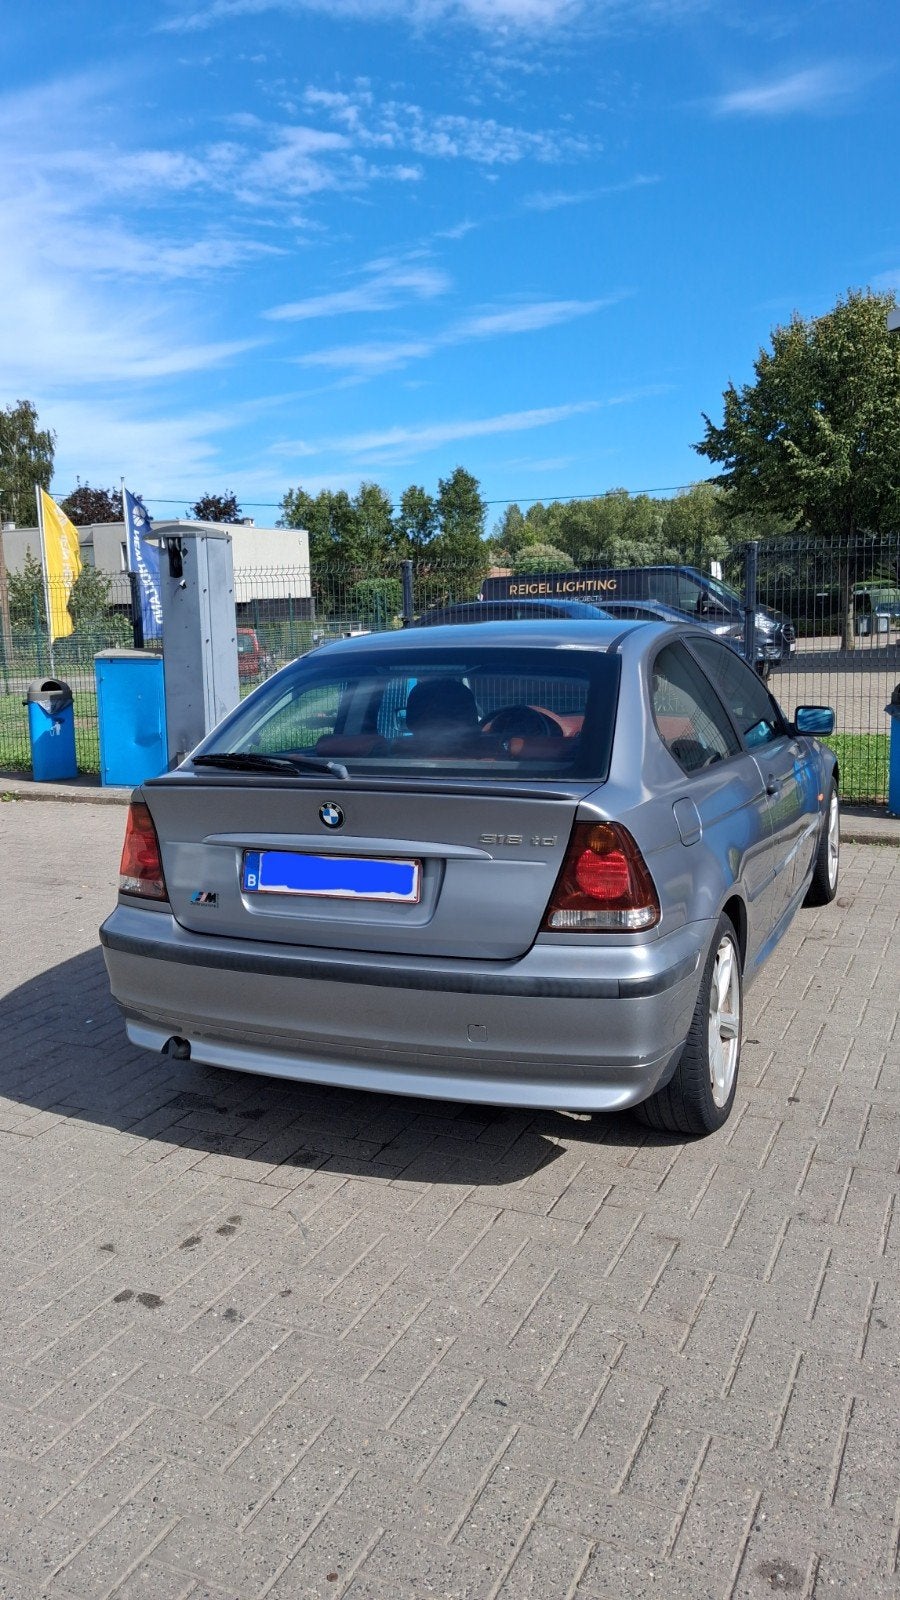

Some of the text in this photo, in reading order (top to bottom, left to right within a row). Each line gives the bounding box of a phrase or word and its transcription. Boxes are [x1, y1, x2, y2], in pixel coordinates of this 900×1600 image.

[509, 579, 617, 595] REIGEL LIGHTING
[479, 833, 558, 846] 318 td
[247, 873, 256, 887] B
